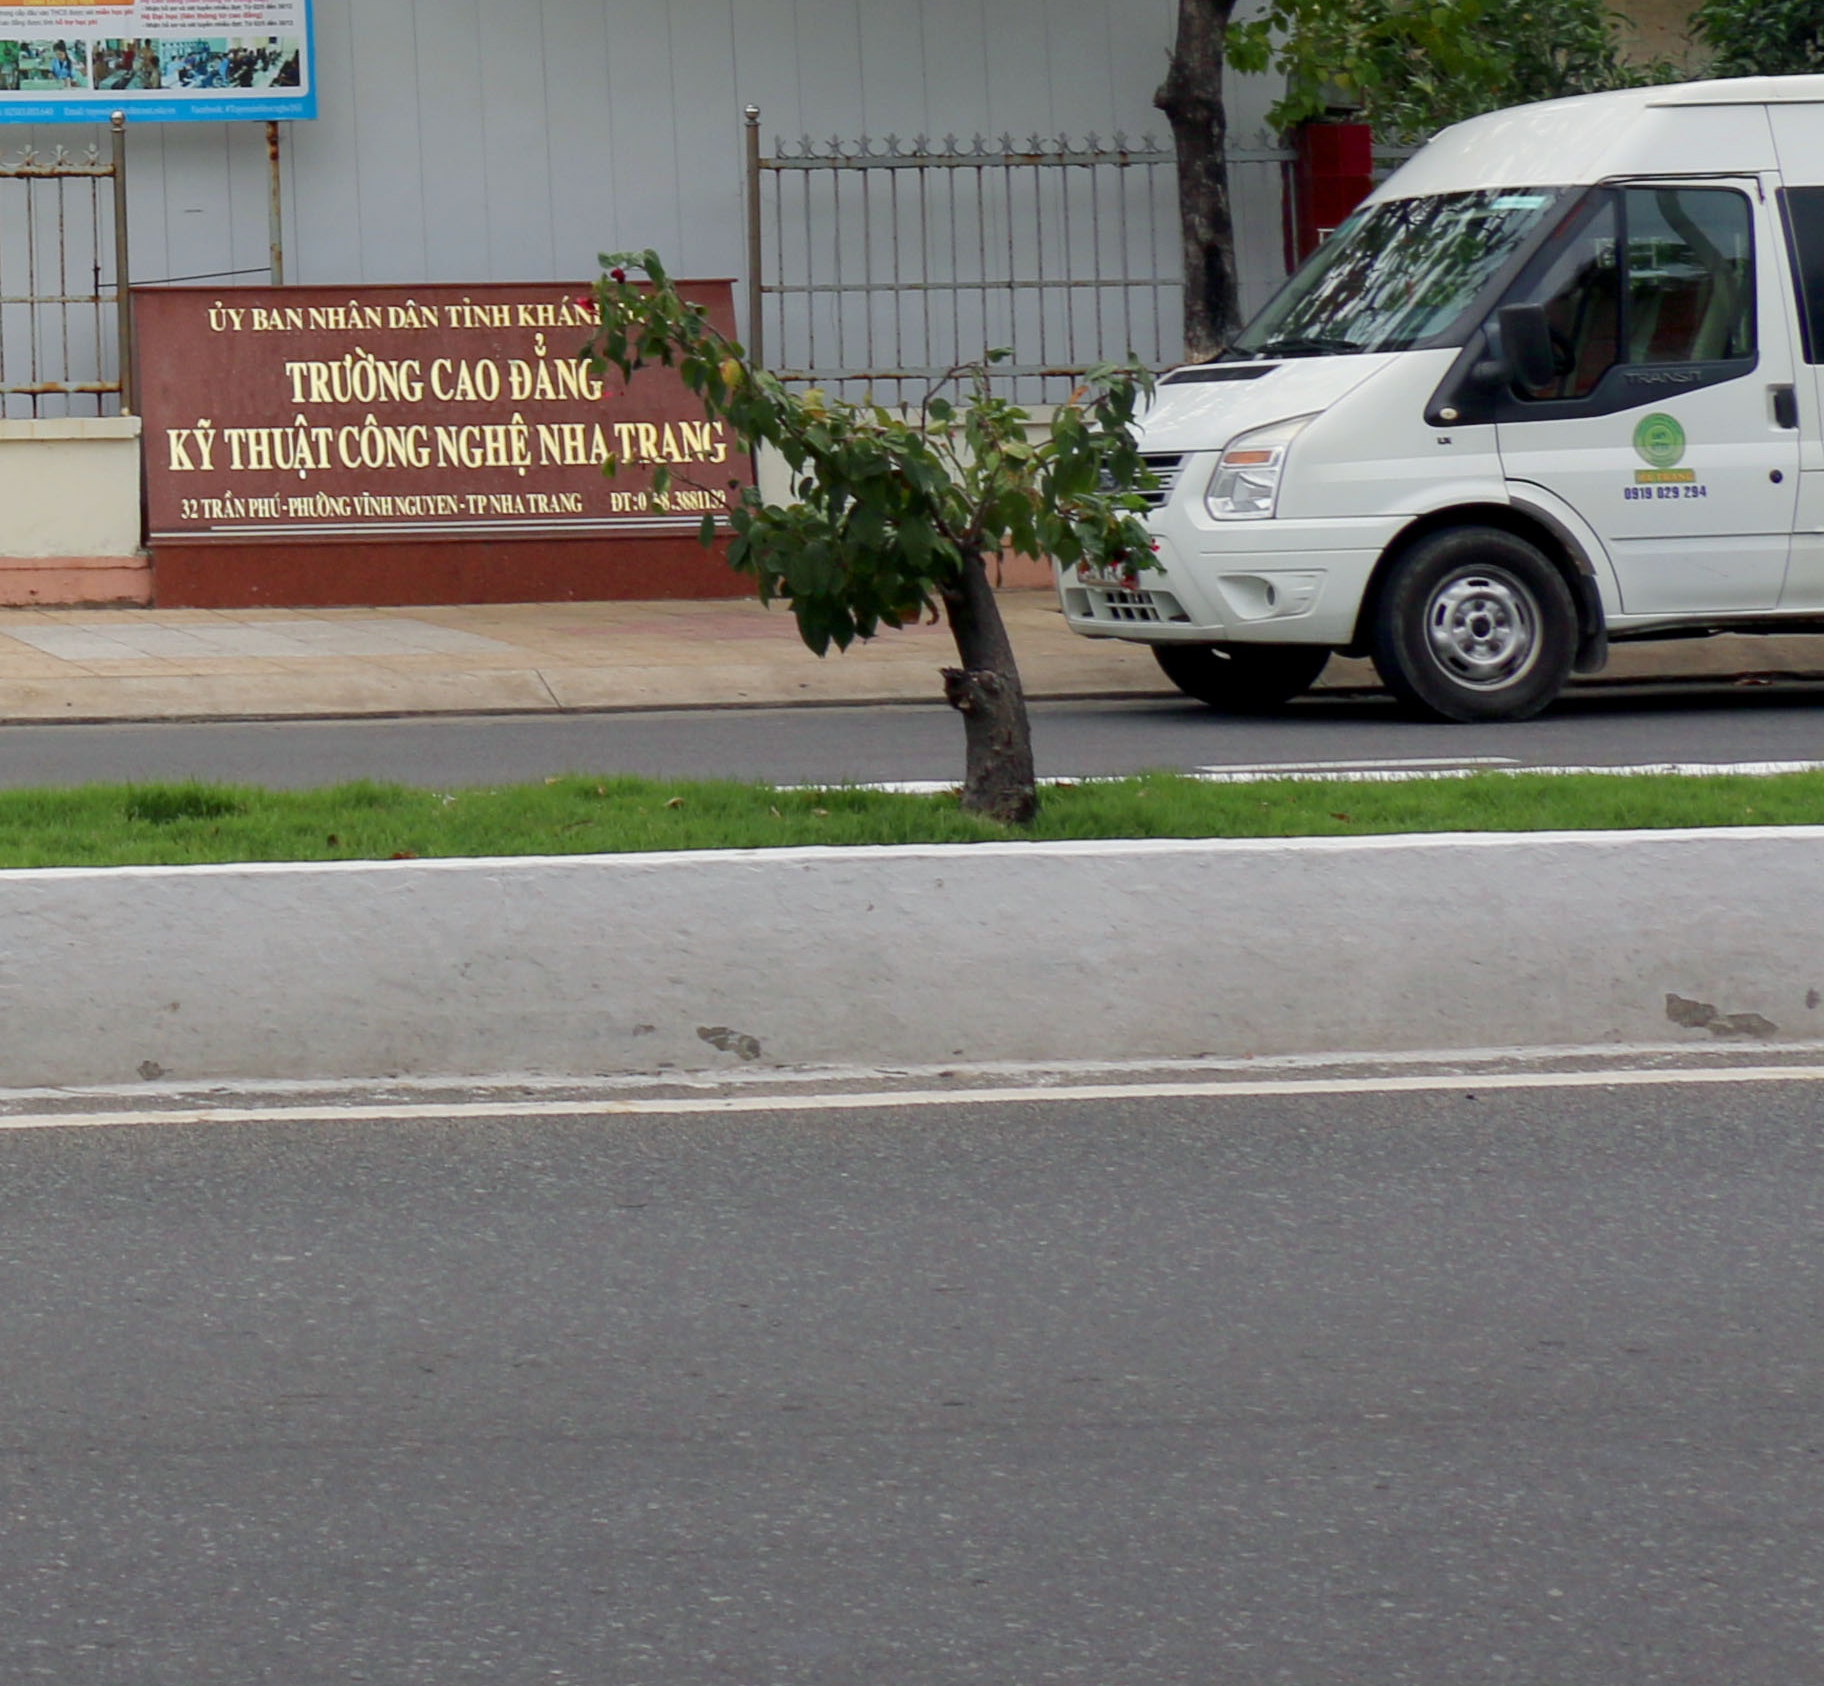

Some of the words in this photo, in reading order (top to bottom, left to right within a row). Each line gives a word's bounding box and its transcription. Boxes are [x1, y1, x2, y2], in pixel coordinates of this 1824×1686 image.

[208, 300, 246, 332] ỦY
[252, 307, 304, 331] BAN
[307, 299, 382, 330] NHÂN
[387, 298, 440, 329] DÂN
[445, 297, 512, 328] TỈNH
[285, 346, 424, 403] TRƯỜNG
[430, 358, 500, 402] CAO
[507, 331, 604, 402] ĐẲNG
[1623, 370, 1702, 384] TRANSIT
[166, 417, 217, 471] KỸ
[223, 413, 334, 480] THUẬT
[337, 413, 432, 469] CÔNG
[434, 412, 532, 477] NGHỆ
[536, 422, 611, 466] NHA
[614, 420, 728, 465] TRANG
[180, 498, 200, 519] 32
[200, 490, 247, 518] TRẦN
[353, 490, 393, 517] VĨNH
[486, 493, 524, 514] NHA
[526, 492, 583, 514] TRANG
[1624, 486, 1652, 500] 0919
[1657, 485, 1680, 499] 029
[1683, 484, 1707, 498] 294
